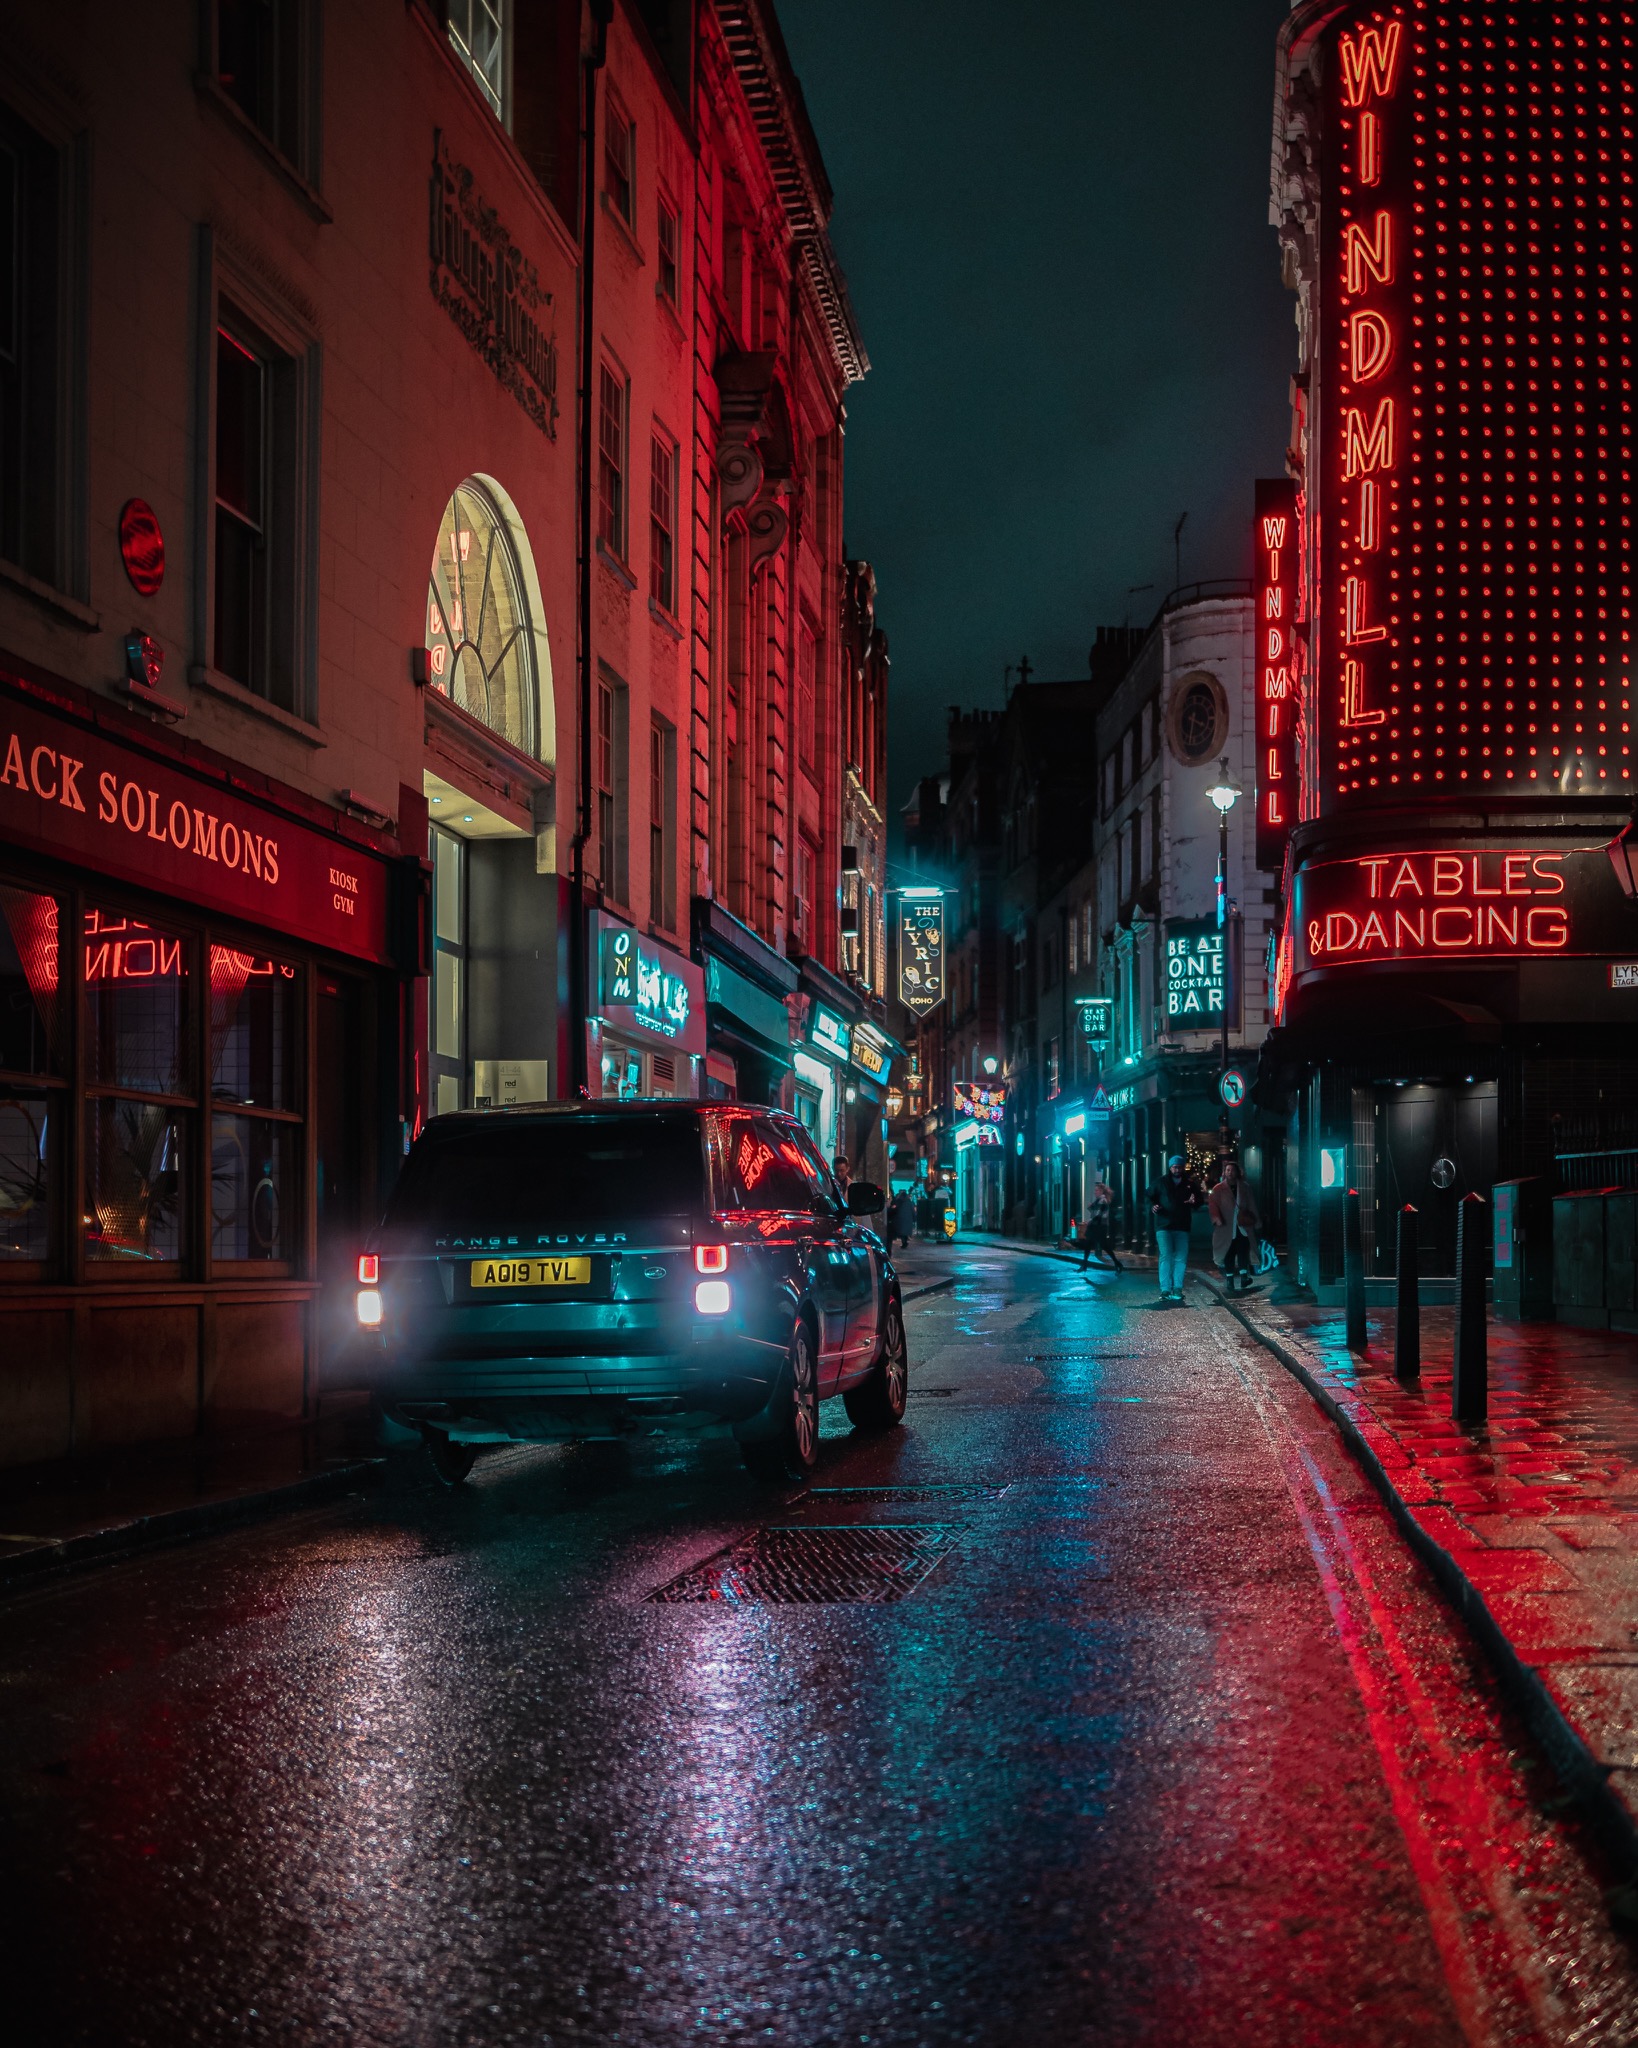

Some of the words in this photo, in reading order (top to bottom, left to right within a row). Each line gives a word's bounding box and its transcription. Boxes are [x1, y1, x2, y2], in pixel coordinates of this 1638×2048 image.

[1342, 21, 1400, 727] WINDMILL
[1263, 517, 1286, 824] WINDMILL
[0, 734, 86, 813] ACK
[99, 771, 279, 885] SOLOMONS
[329, 867, 359, 895] KIOSK
[1359, 855, 1565, 898] TABLES
[333, 894, 355, 916] GYM
[914, 906, 940, 916] THE
[903, 918, 940, 990] LYRIC
[1168, 939, 1187, 957] BE
[1197, 936, 1222, 951] AT
[1168, 954, 1222, 978] ONE
[1168, 977, 1222, 991] COCKTAIL
[1613, 978, 1635, 986] STAGE
[910, 997, 933, 1005] SOHO
[1168, 988, 1223, 1014] BAR
[1085, 1024, 1105, 1032] BAR
[435, 1236, 519, 1247] RANGE
[537, 1232, 627, 1243] ROVER
[537, 1261, 576, 1282] TVL
